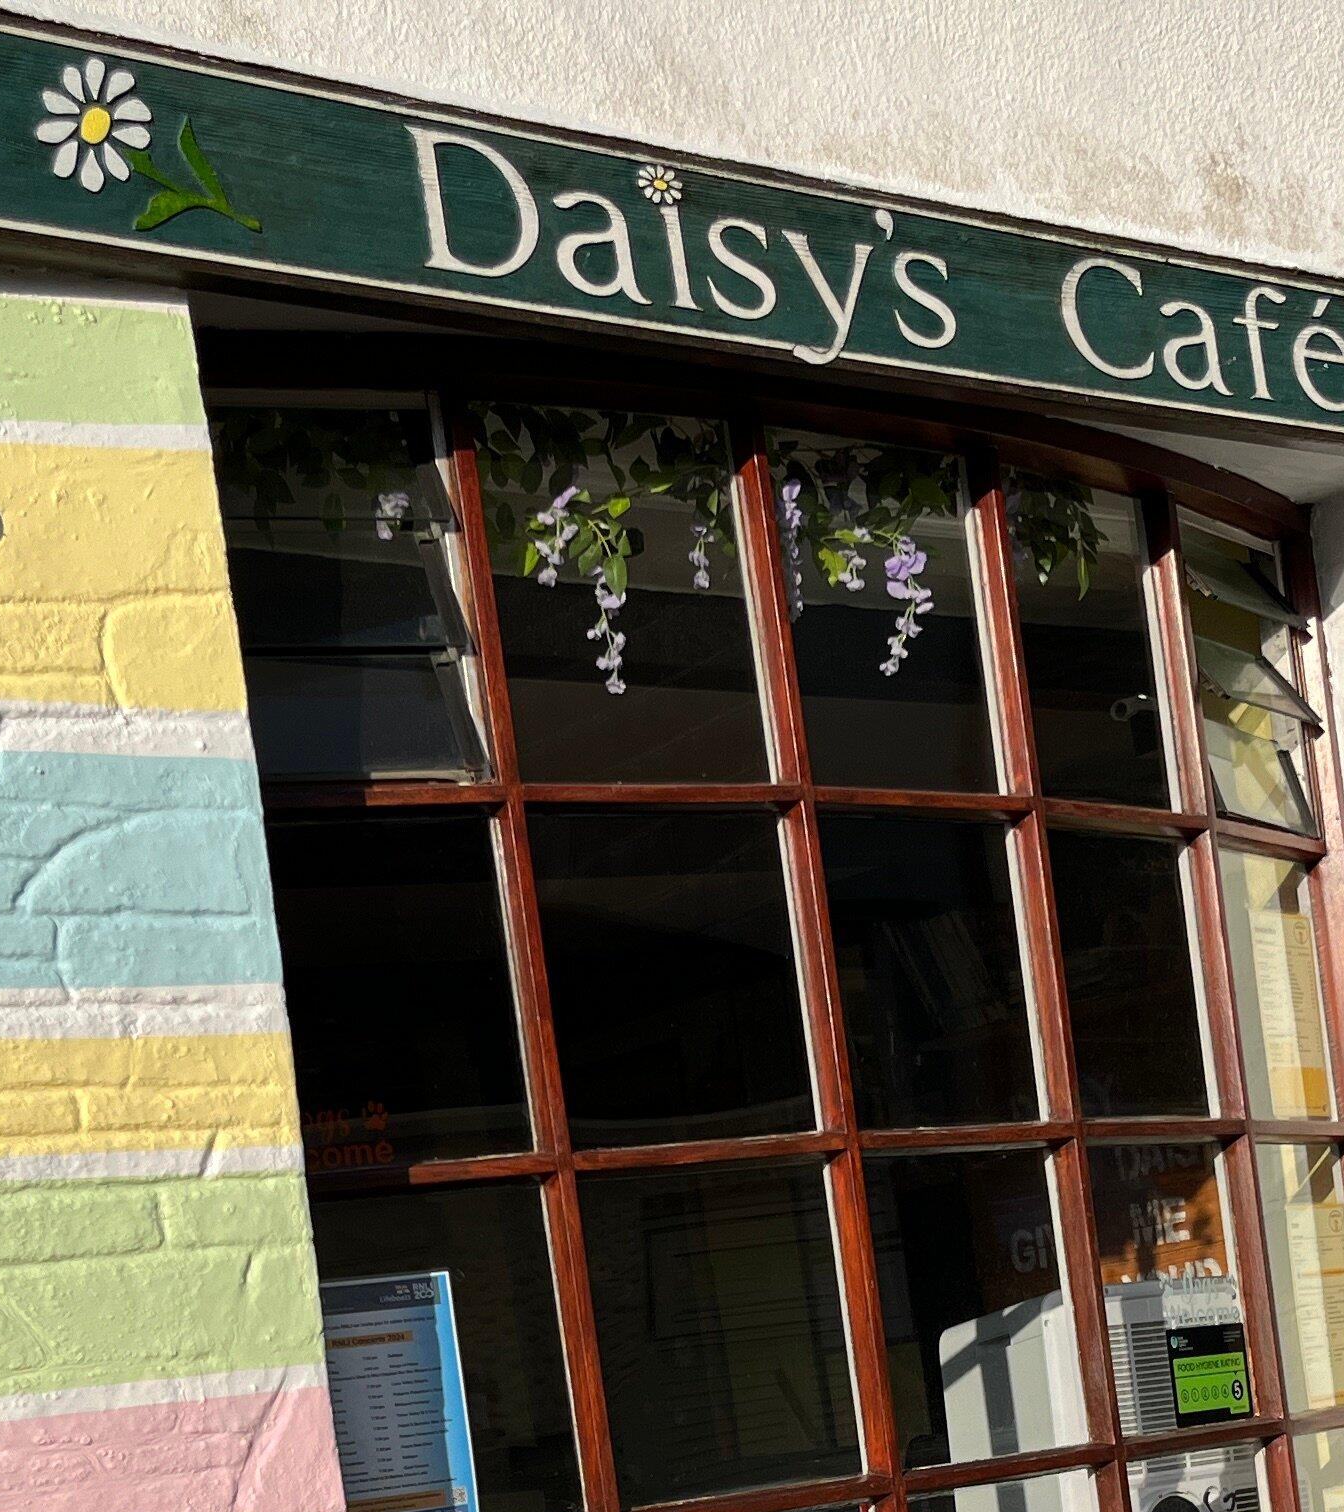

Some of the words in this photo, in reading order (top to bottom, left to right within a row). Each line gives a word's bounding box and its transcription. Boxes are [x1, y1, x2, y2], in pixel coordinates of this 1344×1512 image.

[404, 121, 958, 366] Daisy's
[307, 1138, 396, 1172] come
[1177, 1362, 1195, 1372] FOOD
[1233, 1382, 1242, 1399] 5
